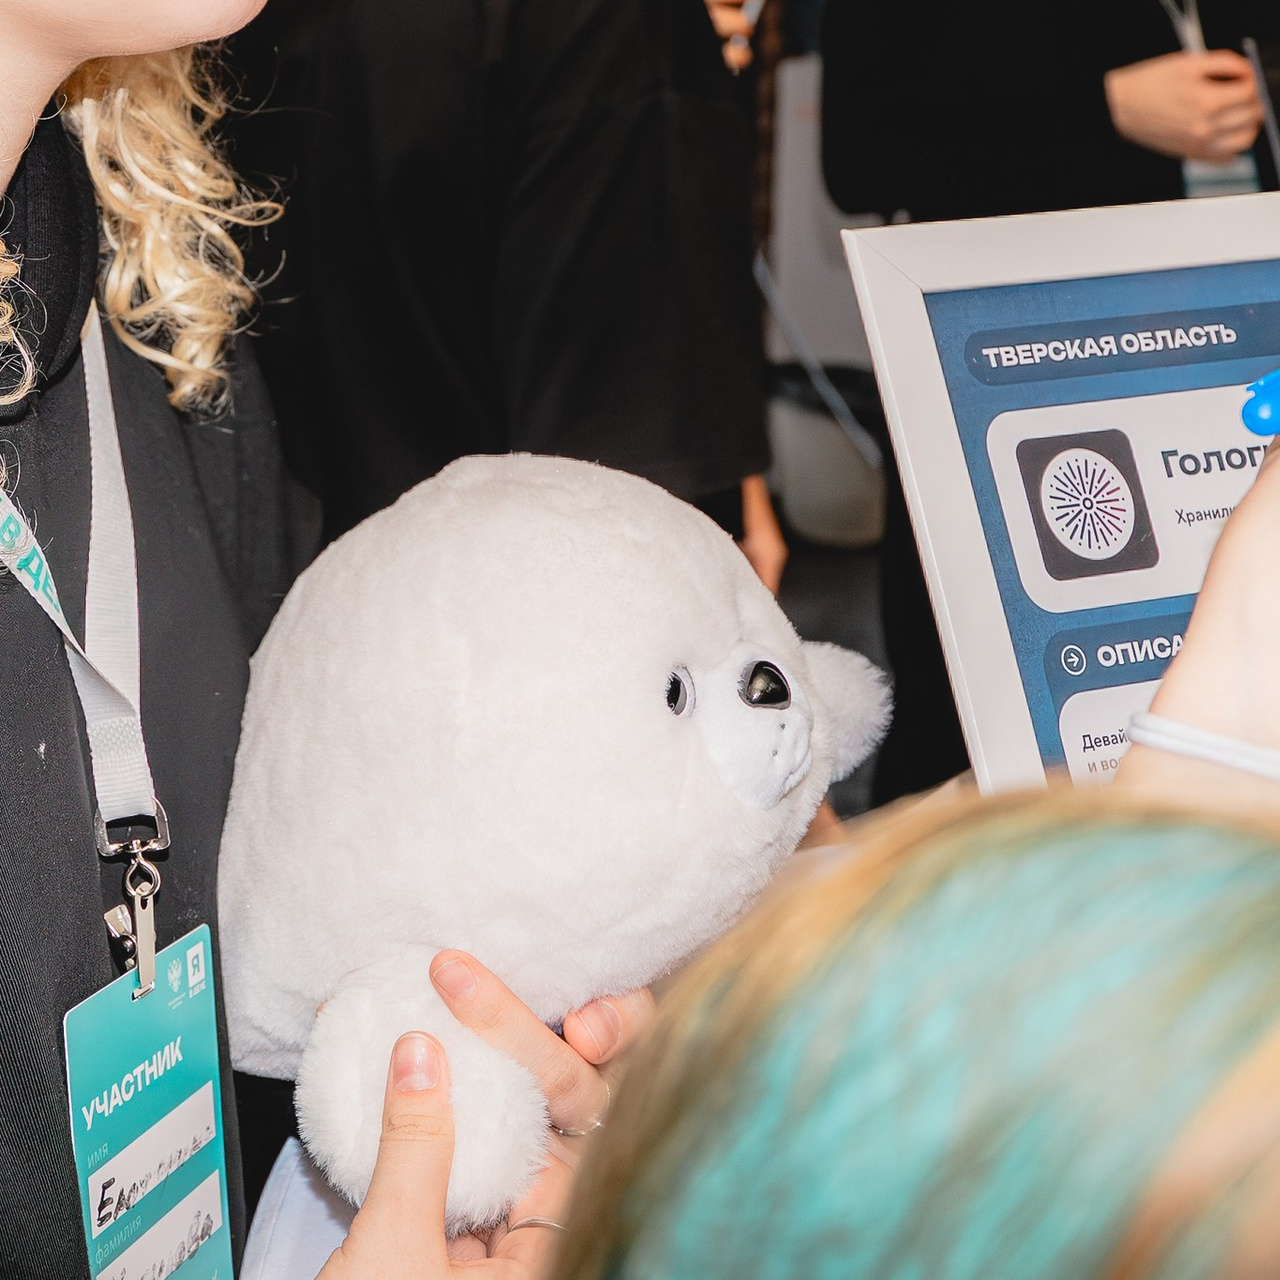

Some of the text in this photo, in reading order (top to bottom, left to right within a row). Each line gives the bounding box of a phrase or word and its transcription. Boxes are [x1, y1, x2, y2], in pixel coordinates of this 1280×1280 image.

[981, 323, 1238, 369] ТВЕРСКАЯ ОБЛАСТЬ
[16, 544, 60, 613] ДЕ
[1082, 728, 1129, 753] Девай
[1087, 761, 1098, 773] и
[191, 953, 201, 977] Я
[81, 1035, 183, 1132] УЧАСТНИК
[87, 1142, 109, 1169] имя
[95, 1215, 142, 1268] фамилия
